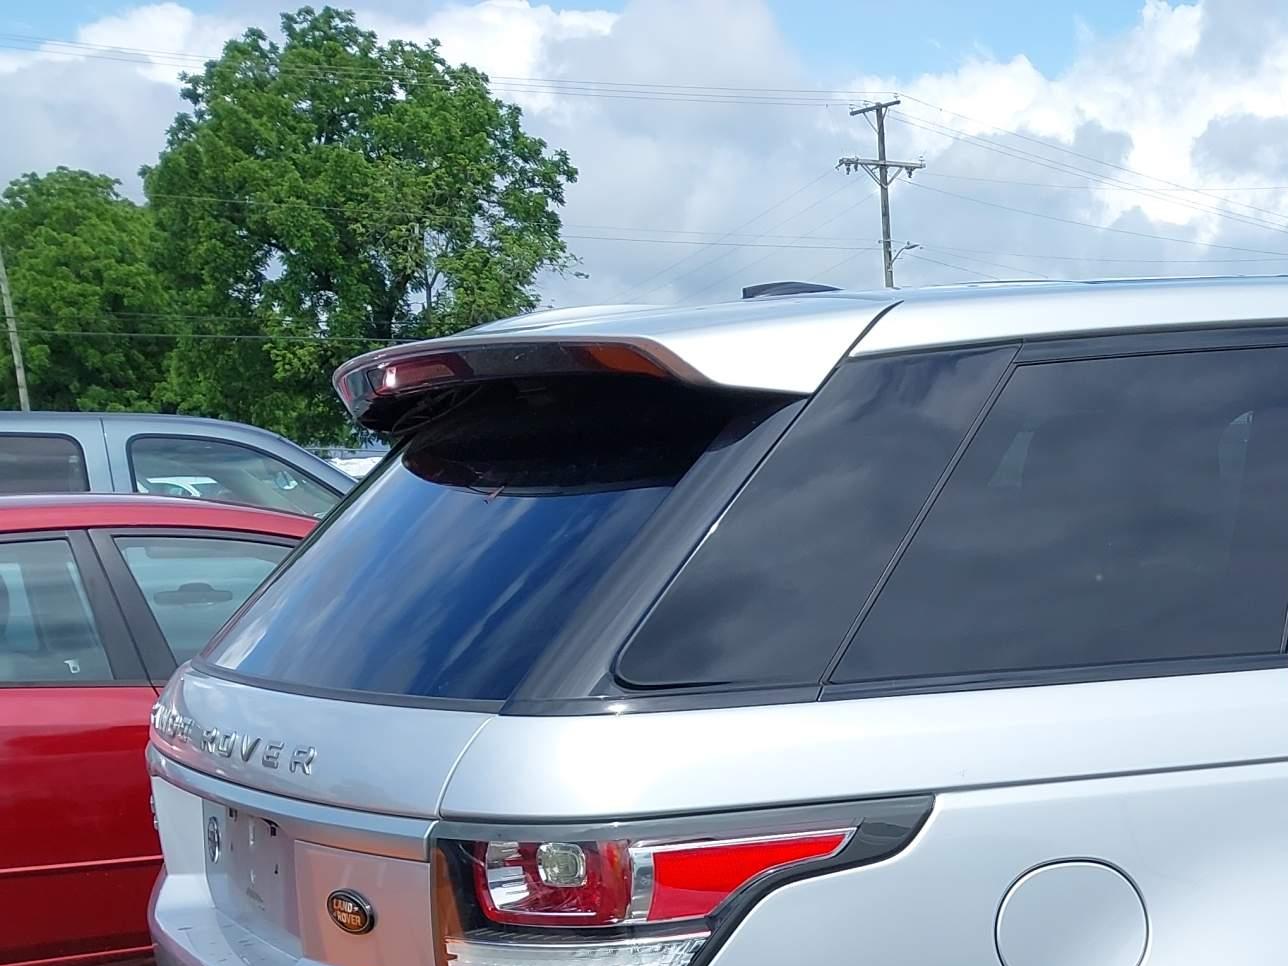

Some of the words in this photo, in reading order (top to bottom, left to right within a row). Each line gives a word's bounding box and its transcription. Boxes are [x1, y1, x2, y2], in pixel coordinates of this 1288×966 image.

[201, 727, 317, 776] ROVER
[332, 897, 354, 914] LAND
[336, 910, 362, 927] ROVER
